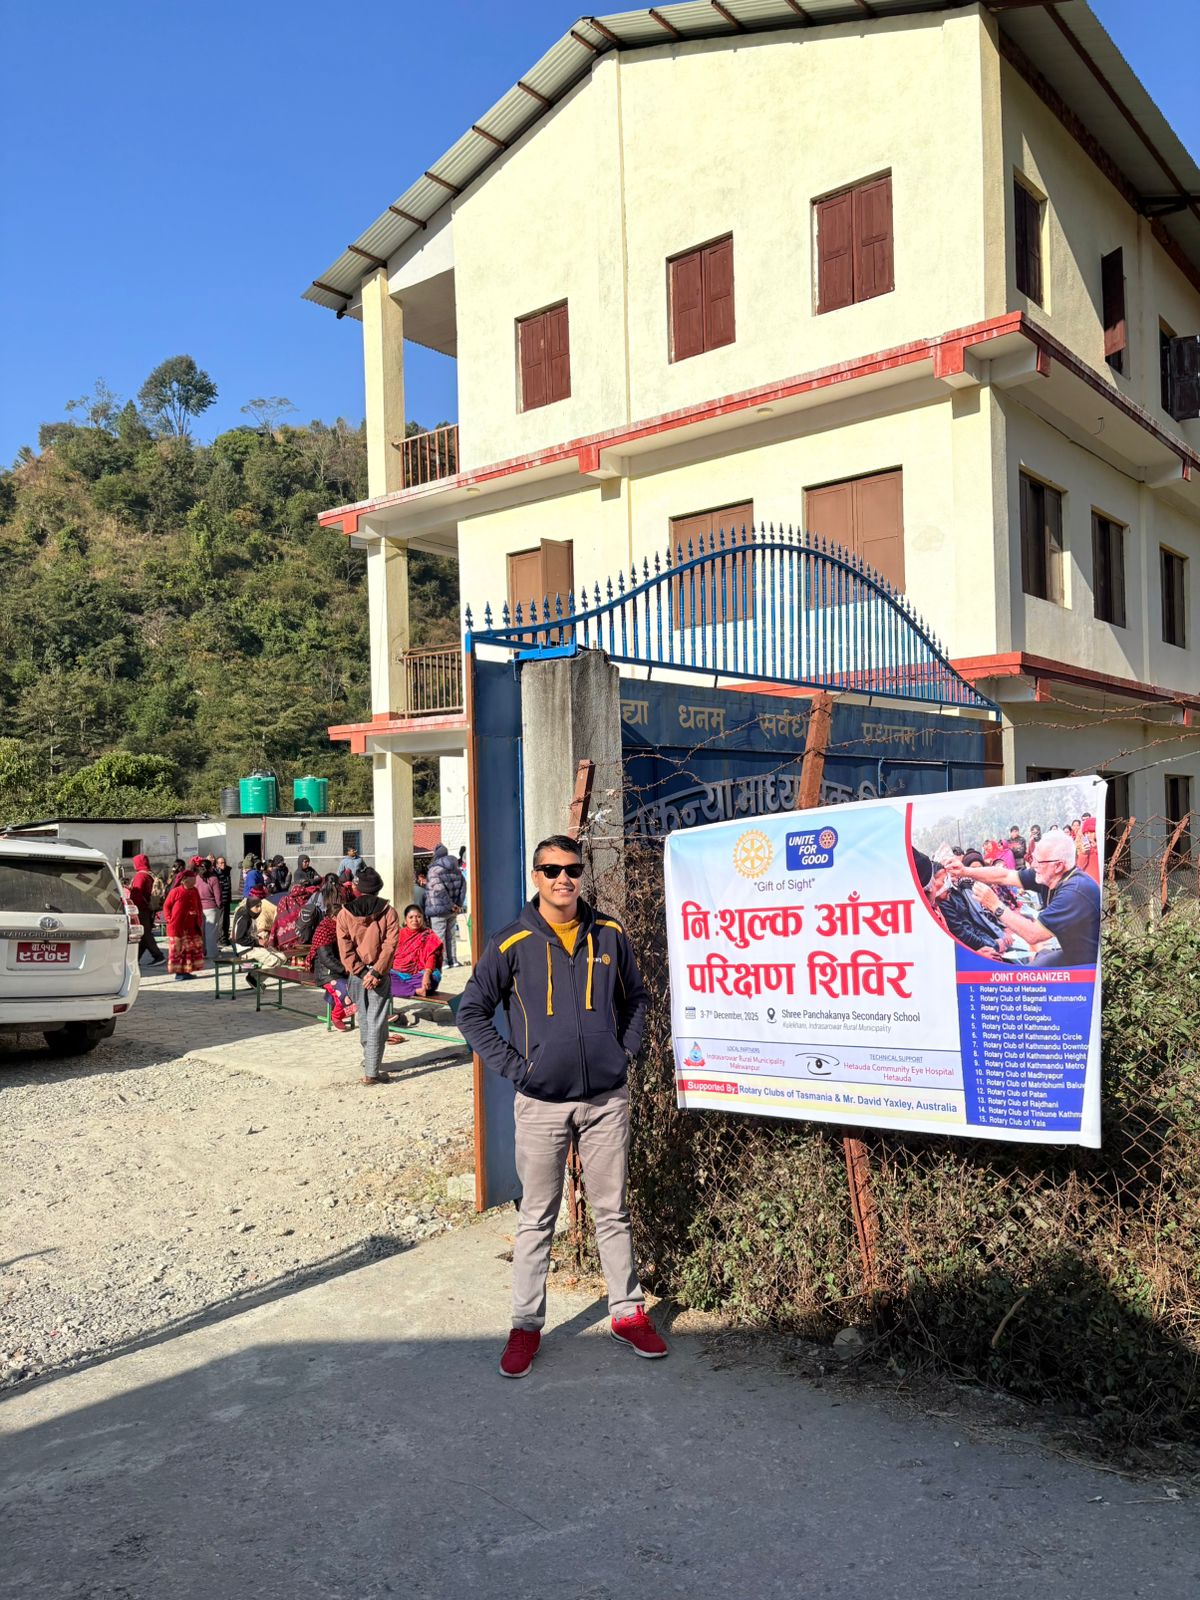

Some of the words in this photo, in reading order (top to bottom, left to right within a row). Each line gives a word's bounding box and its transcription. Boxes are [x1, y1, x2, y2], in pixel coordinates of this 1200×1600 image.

[789, 835, 815, 846] UNITE
[798, 845, 817, 855] FOR
[802, 854, 828, 865] GOOD
[776, 880, 785, 890] of
[814, 890, 915, 937] आँखा
[686, 952, 795, 999] परिक्षण
[807, 949, 914, 998] शिविर
[990, 972, 1014, 982] JOINT
[1016, 972, 1070, 982] ORGANIZER
[980, 986, 998, 994] Rotary
[1022, 995, 1047, 1003] Bagmati
[981, 1004, 999, 1012] Rotary
[744, 1012, 759, 1021] 2025
[782, 1010, 802, 1018] Shree
[803, 1010, 850, 1021] Panchakanya
[852, 1011, 892, 1023] Secondary
[893, 1012, 920, 1022] School
[1024, 1014, 1052, 1022] Gongabu
[842, 1023, 858, 1031] Rural
[858, 1024, 892, 1033] Municipality
[983, 1032, 1002, 1040] Rotary
[870, 1054, 897, 1062] TECHNICAL
[984, 1051, 1002, 1059] Rotary
[1026, 1052, 1062, 1060] Kathmandu
[754, 1056, 785, 1066] Municipality
[985, 1060, 1004, 1068] Rotary
[844, 1062, 870, 1070] Hetauda
[872, 1064, 910, 1074] Community
[911, 1066, 924, 1075] Eye
[925, 1066, 954, 1076] Hospital
[884, 1074, 912, 1082] Hetauda
[986, 1070, 1004, 1078] Rotary
[1028, 1072, 1063, 1080] Madhyapur
[688, 1081, 725, 1092] Supported
[726, 1083, 738, 1094] By:
[986, 1079, 1004, 1088] Rotary
[988, 1088, 1006, 1096] Rotary
[740, 1085, 762, 1096] Rotary
[764, 1087, 784, 1098] Clubs
[787, 1088, 794, 1098] of
[796, 1090, 832, 1101] Tasmania
[835, 1094, 840, 1102] &
[842, 1094, 856, 1104] Mr.
[858, 1096, 882, 1106] David
[884, 1098, 914, 1110] Yaxley,
[916, 1101, 957, 1112] Australia
[988, 1098, 1006, 1106] Rotary
[1030, 1100, 1058, 1108] Rajdhani
[988, 1108, 1007, 1116] Rotary
[1008, 1108, 1022, 1116] Club
[1031, 1110, 1056, 1118] Tinkune
[990, 1117, 1008, 1125] Rotary
